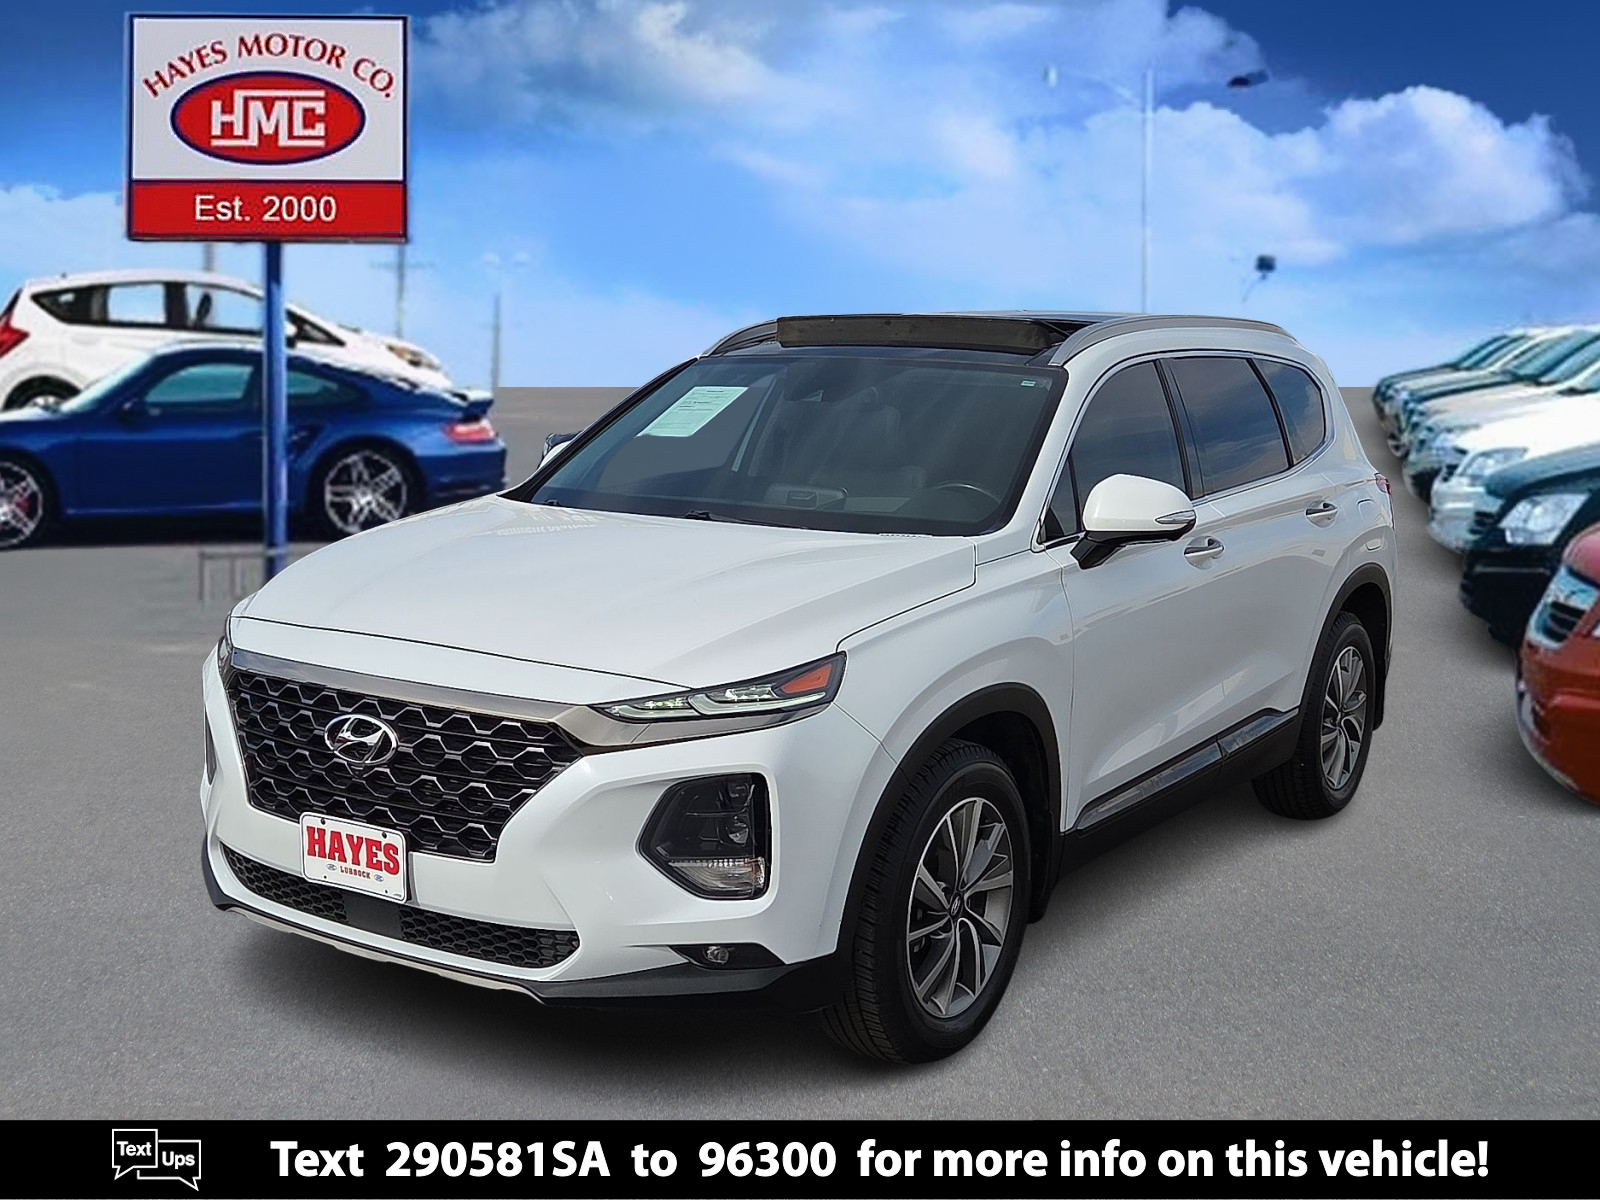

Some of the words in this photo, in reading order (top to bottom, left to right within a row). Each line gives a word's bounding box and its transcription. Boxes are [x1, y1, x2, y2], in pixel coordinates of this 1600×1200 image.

[142, 40, 228, 97] HAYES
[237, 33, 346, 69] MOTOR
[352, 58, 394, 98] CO.
[210, 90, 326, 147] HMC
[194, 195, 250, 221] Est.
[262, 196, 337, 222] 2000
[306, 825, 400, 876] HAYES
[339, 865, 371, 879] LUBBOCK
